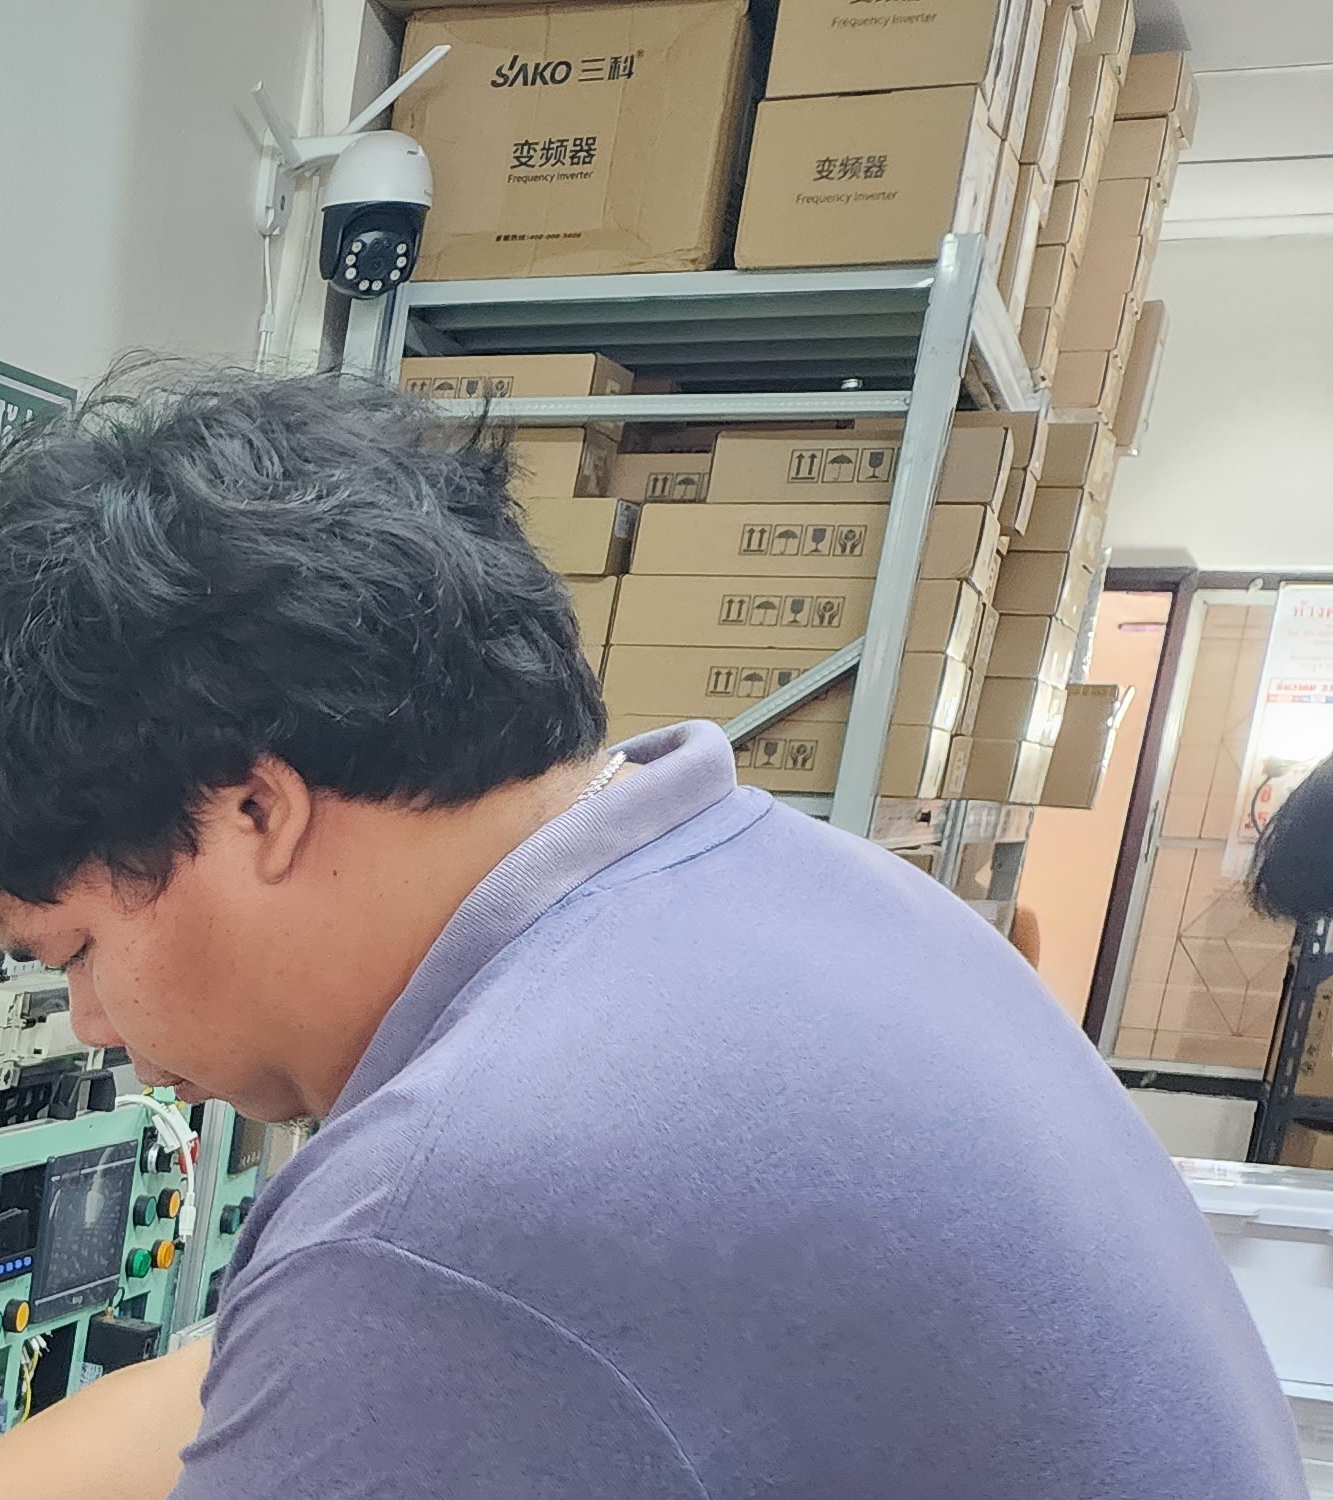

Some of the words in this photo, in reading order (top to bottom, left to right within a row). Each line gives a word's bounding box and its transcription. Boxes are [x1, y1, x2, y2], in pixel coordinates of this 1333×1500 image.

[831, 15, 890, 28] Frequency
[892, 12, 937, 24] Inverter
[491, 55, 572, 88] SAKO
[510, 136, 597, 169] 变频器
[507, 173, 555, 184] Frequency
[556, 170, 593, 180] Inverter
[813, 155, 887, 182] 变频器
[796, 192, 851, 205] Frequency
[854, 190, 898, 202] Inverter
